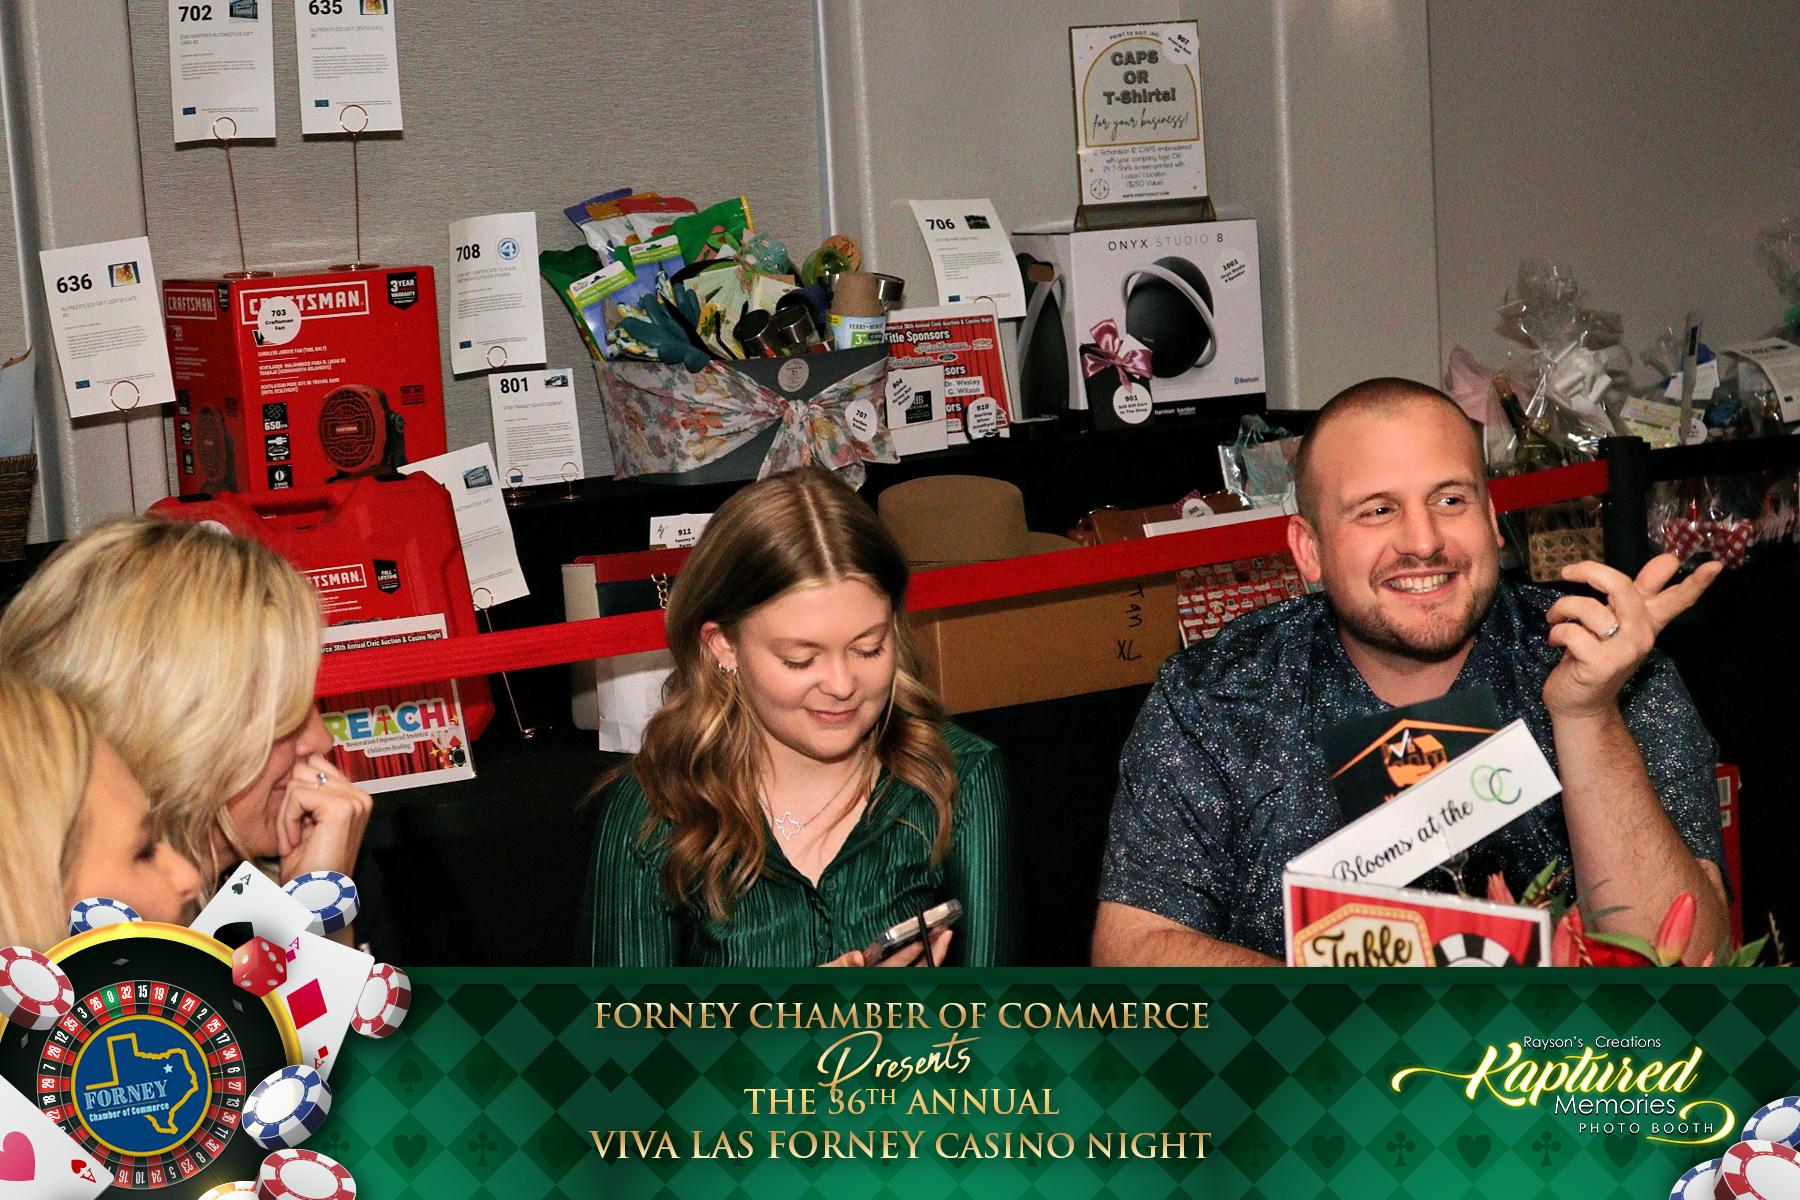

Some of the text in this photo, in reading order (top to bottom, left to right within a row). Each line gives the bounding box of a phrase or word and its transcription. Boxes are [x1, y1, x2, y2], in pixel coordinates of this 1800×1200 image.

[178, 6, 212, 22] 702
[308, 0, 344, 16] 635
[1111, 50, 1158, 66] CAPS
[1124, 70, 1149, 84] OR
[1102, 87, 1176, 106] T-Shirts!
[1092, 114, 1110, 139] for
[1110, 118, 1138, 141] your
[926, 218, 956, 230] 706
[1108, 233, 1224, 250] ONYX STUDIO 8
[456, 244, 480, 262] 708
[1222, 259, 1239, 271] 1001
[56, 274, 93, 294] 636
[390, 279, 415, 292] 3 YEAR
[168, 296, 213, 312] CRAFTSMAN
[250, 291, 360, 315] CTSMAN
[271, 309, 286, 317] 703
[886, 333, 905, 343] Title
[906, 330, 950, 344] Sponsors
[500, 376, 528, 394] 801
[957, 379, 980, 388] Wesley
[856, 410, 868, 419] 707
[976, 404, 990, 412] 910
[264, 421, 280, 431] 650
[678, 528, 692, 536] 911
[347, 642, 366, 650] Annual
[366, 640, 380, 648] Civic
[380, 637, 402, 646] Auction
[408, 634, 426, 642] Casino
[426, 632, 442, 641] Night
[1117, 640, 1142, 661] XL
[322, 702, 459, 742] REACH!
[1332, 799, 1474, 882] Blooms at the
[1312, 925, 1412, 967] Table
